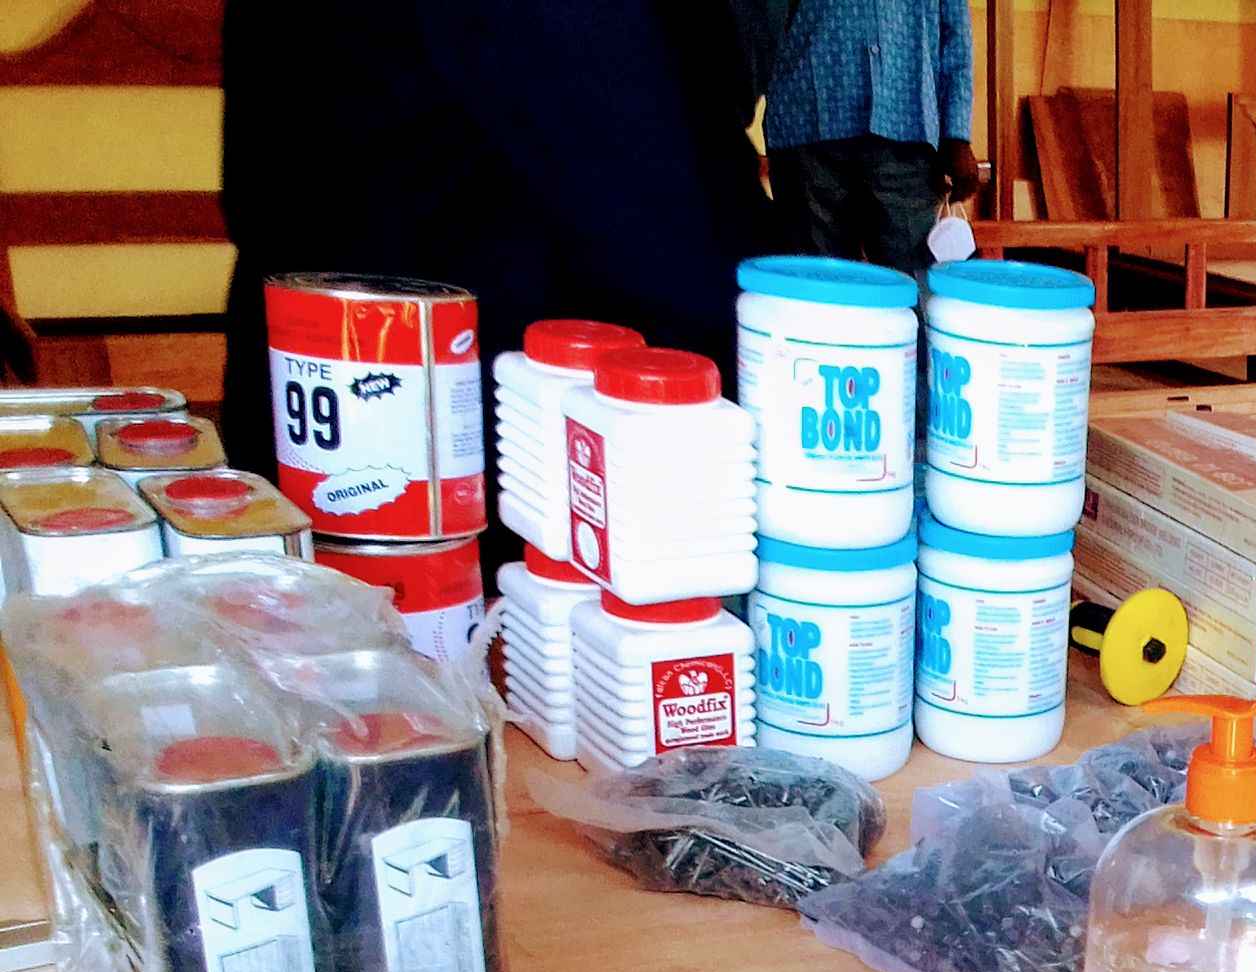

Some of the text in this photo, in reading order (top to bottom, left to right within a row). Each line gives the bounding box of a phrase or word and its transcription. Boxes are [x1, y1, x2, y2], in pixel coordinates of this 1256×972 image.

[284, 356, 332, 380] TYPE
[358, 376, 390, 395] NEW
[819, 365, 880, 410] TOP
[286, 381, 341, 451] 99
[801, 406, 881, 452] BOND
[326, 479, 390, 502] ORIGINAL
[767, 613, 821, 660] TOP
[662, 697, 727, 718] Woodfix
